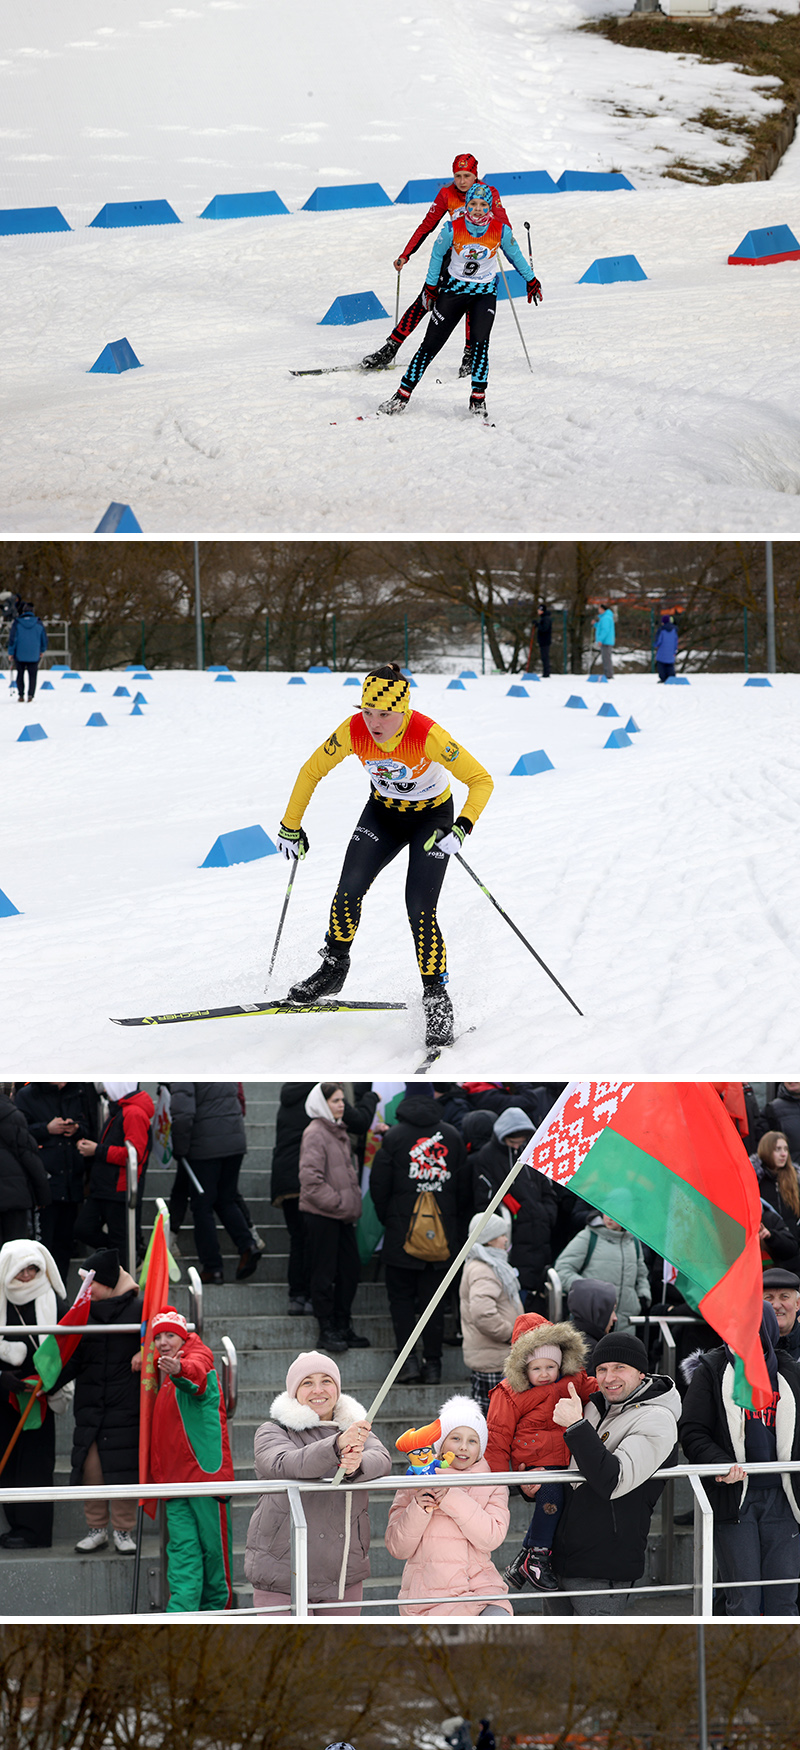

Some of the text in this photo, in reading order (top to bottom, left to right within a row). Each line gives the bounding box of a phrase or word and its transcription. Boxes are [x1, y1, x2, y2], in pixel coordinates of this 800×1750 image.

[464, 261, 480, 276] 9
[157, 1010, 210, 1022] FISCHER
[274, 1005, 340, 1015] FISCHER
